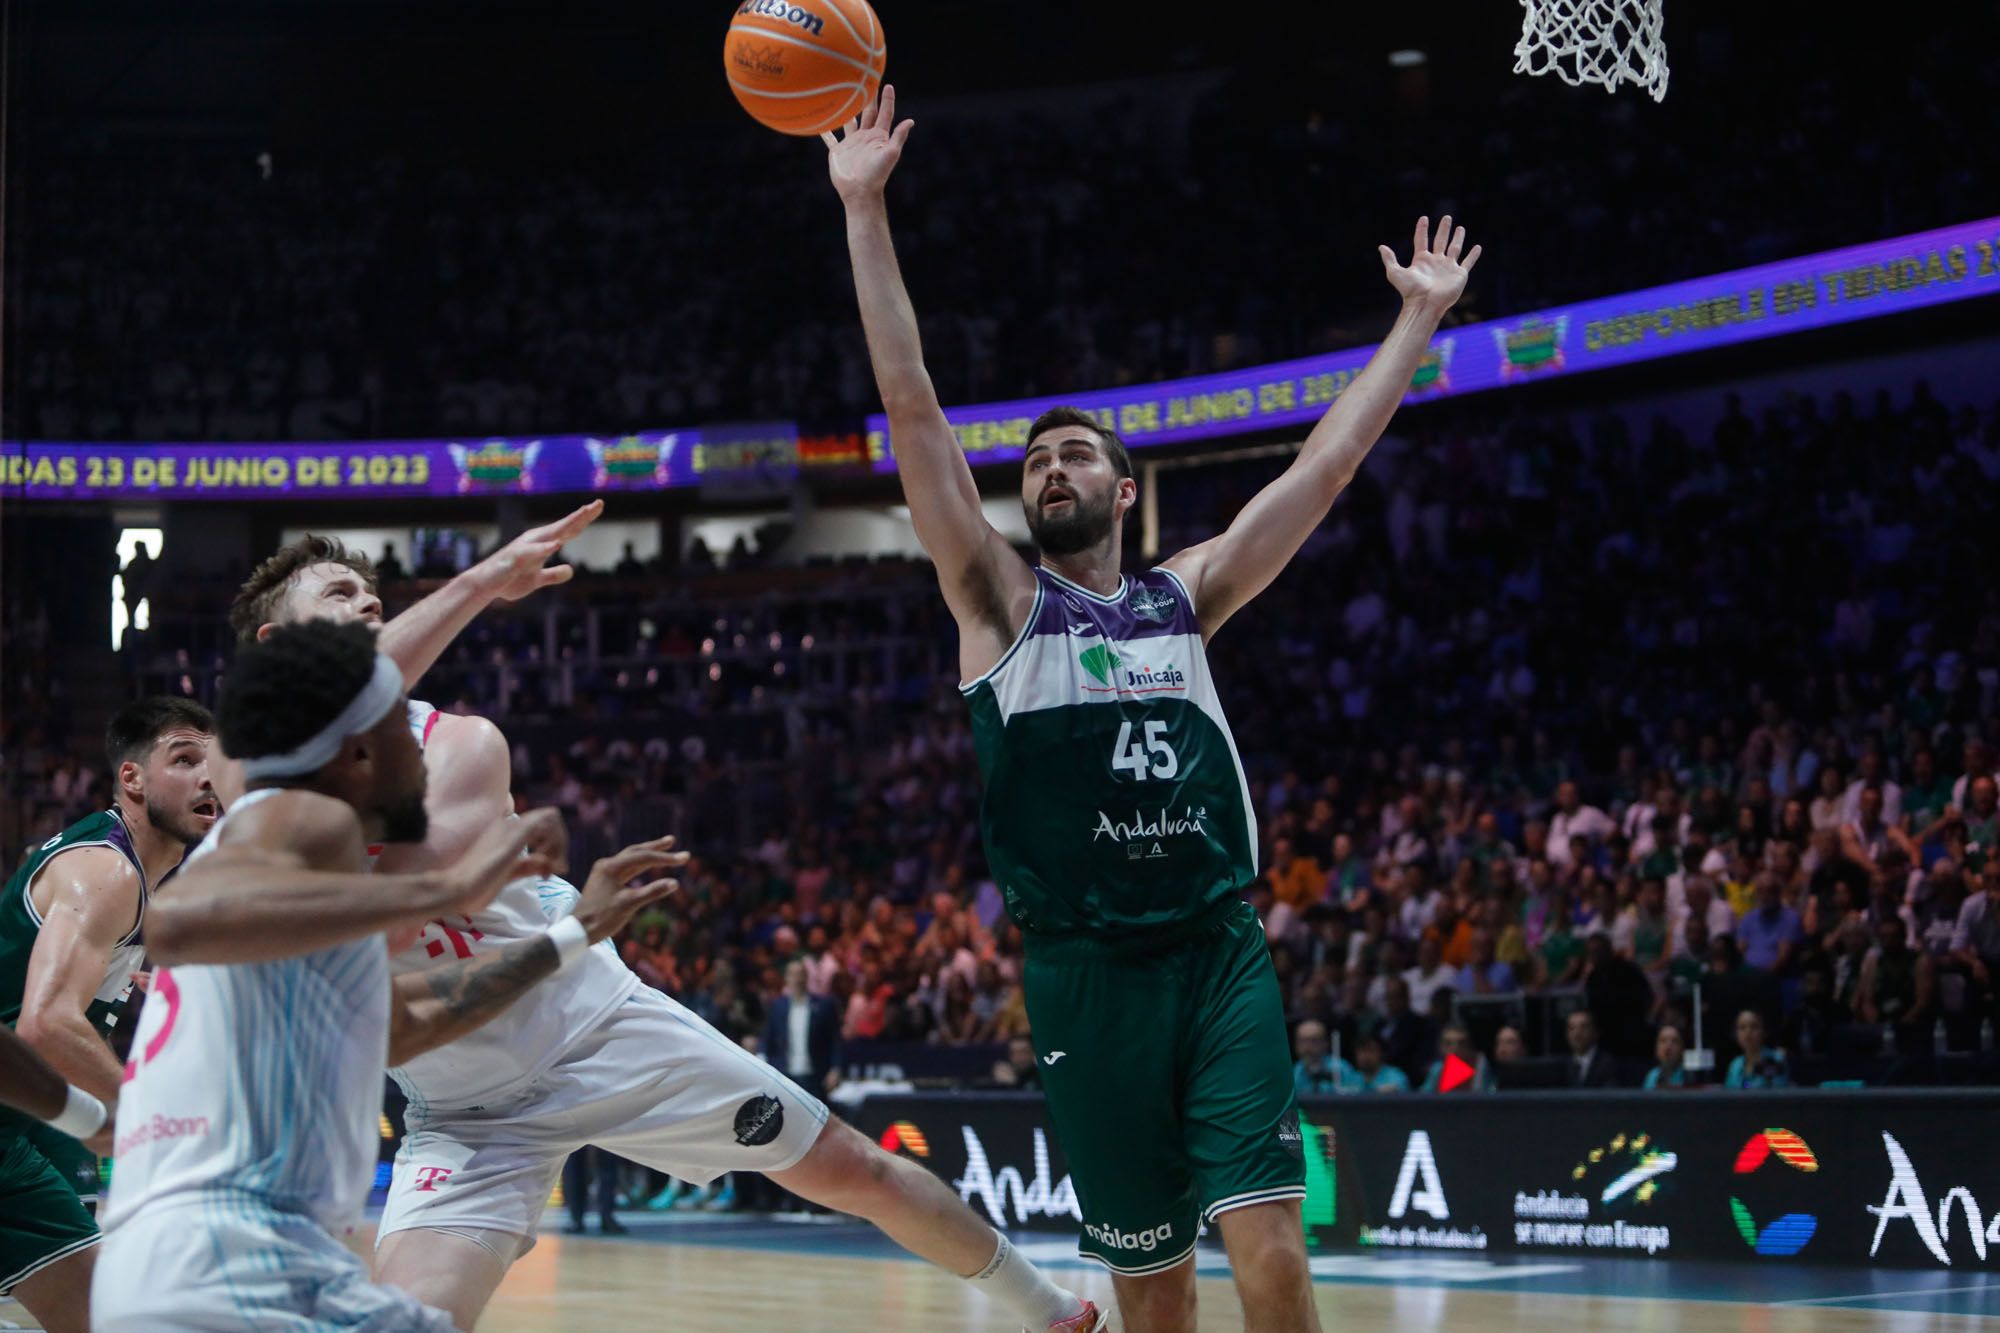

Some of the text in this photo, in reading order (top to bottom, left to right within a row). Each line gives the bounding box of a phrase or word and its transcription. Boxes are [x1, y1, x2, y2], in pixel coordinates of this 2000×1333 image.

[1774, 278, 1816, 315] EN
[1822, 244, 1967, 306] TIENDAS
[1119, 402, 1161, 434] DE
[1165, 388, 1254, 430] JUNIO
[1258, 381, 1296, 414] DE
[84, 456, 124, 487] 23
[132, 456, 177, 487] DE
[183, 456, 289, 487] JUNIO
[295, 455, 340, 487] DE
[347, 454, 429, 486] 2023
[1153, 597, 1175, 609] FOUR
[1111, 720, 1178, 782] 45
[1091, 805, 1207, 842] Andalucía
[740, 1101, 780, 1143] FINAL FOUR
[1387, 1128, 1451, 1220] A
